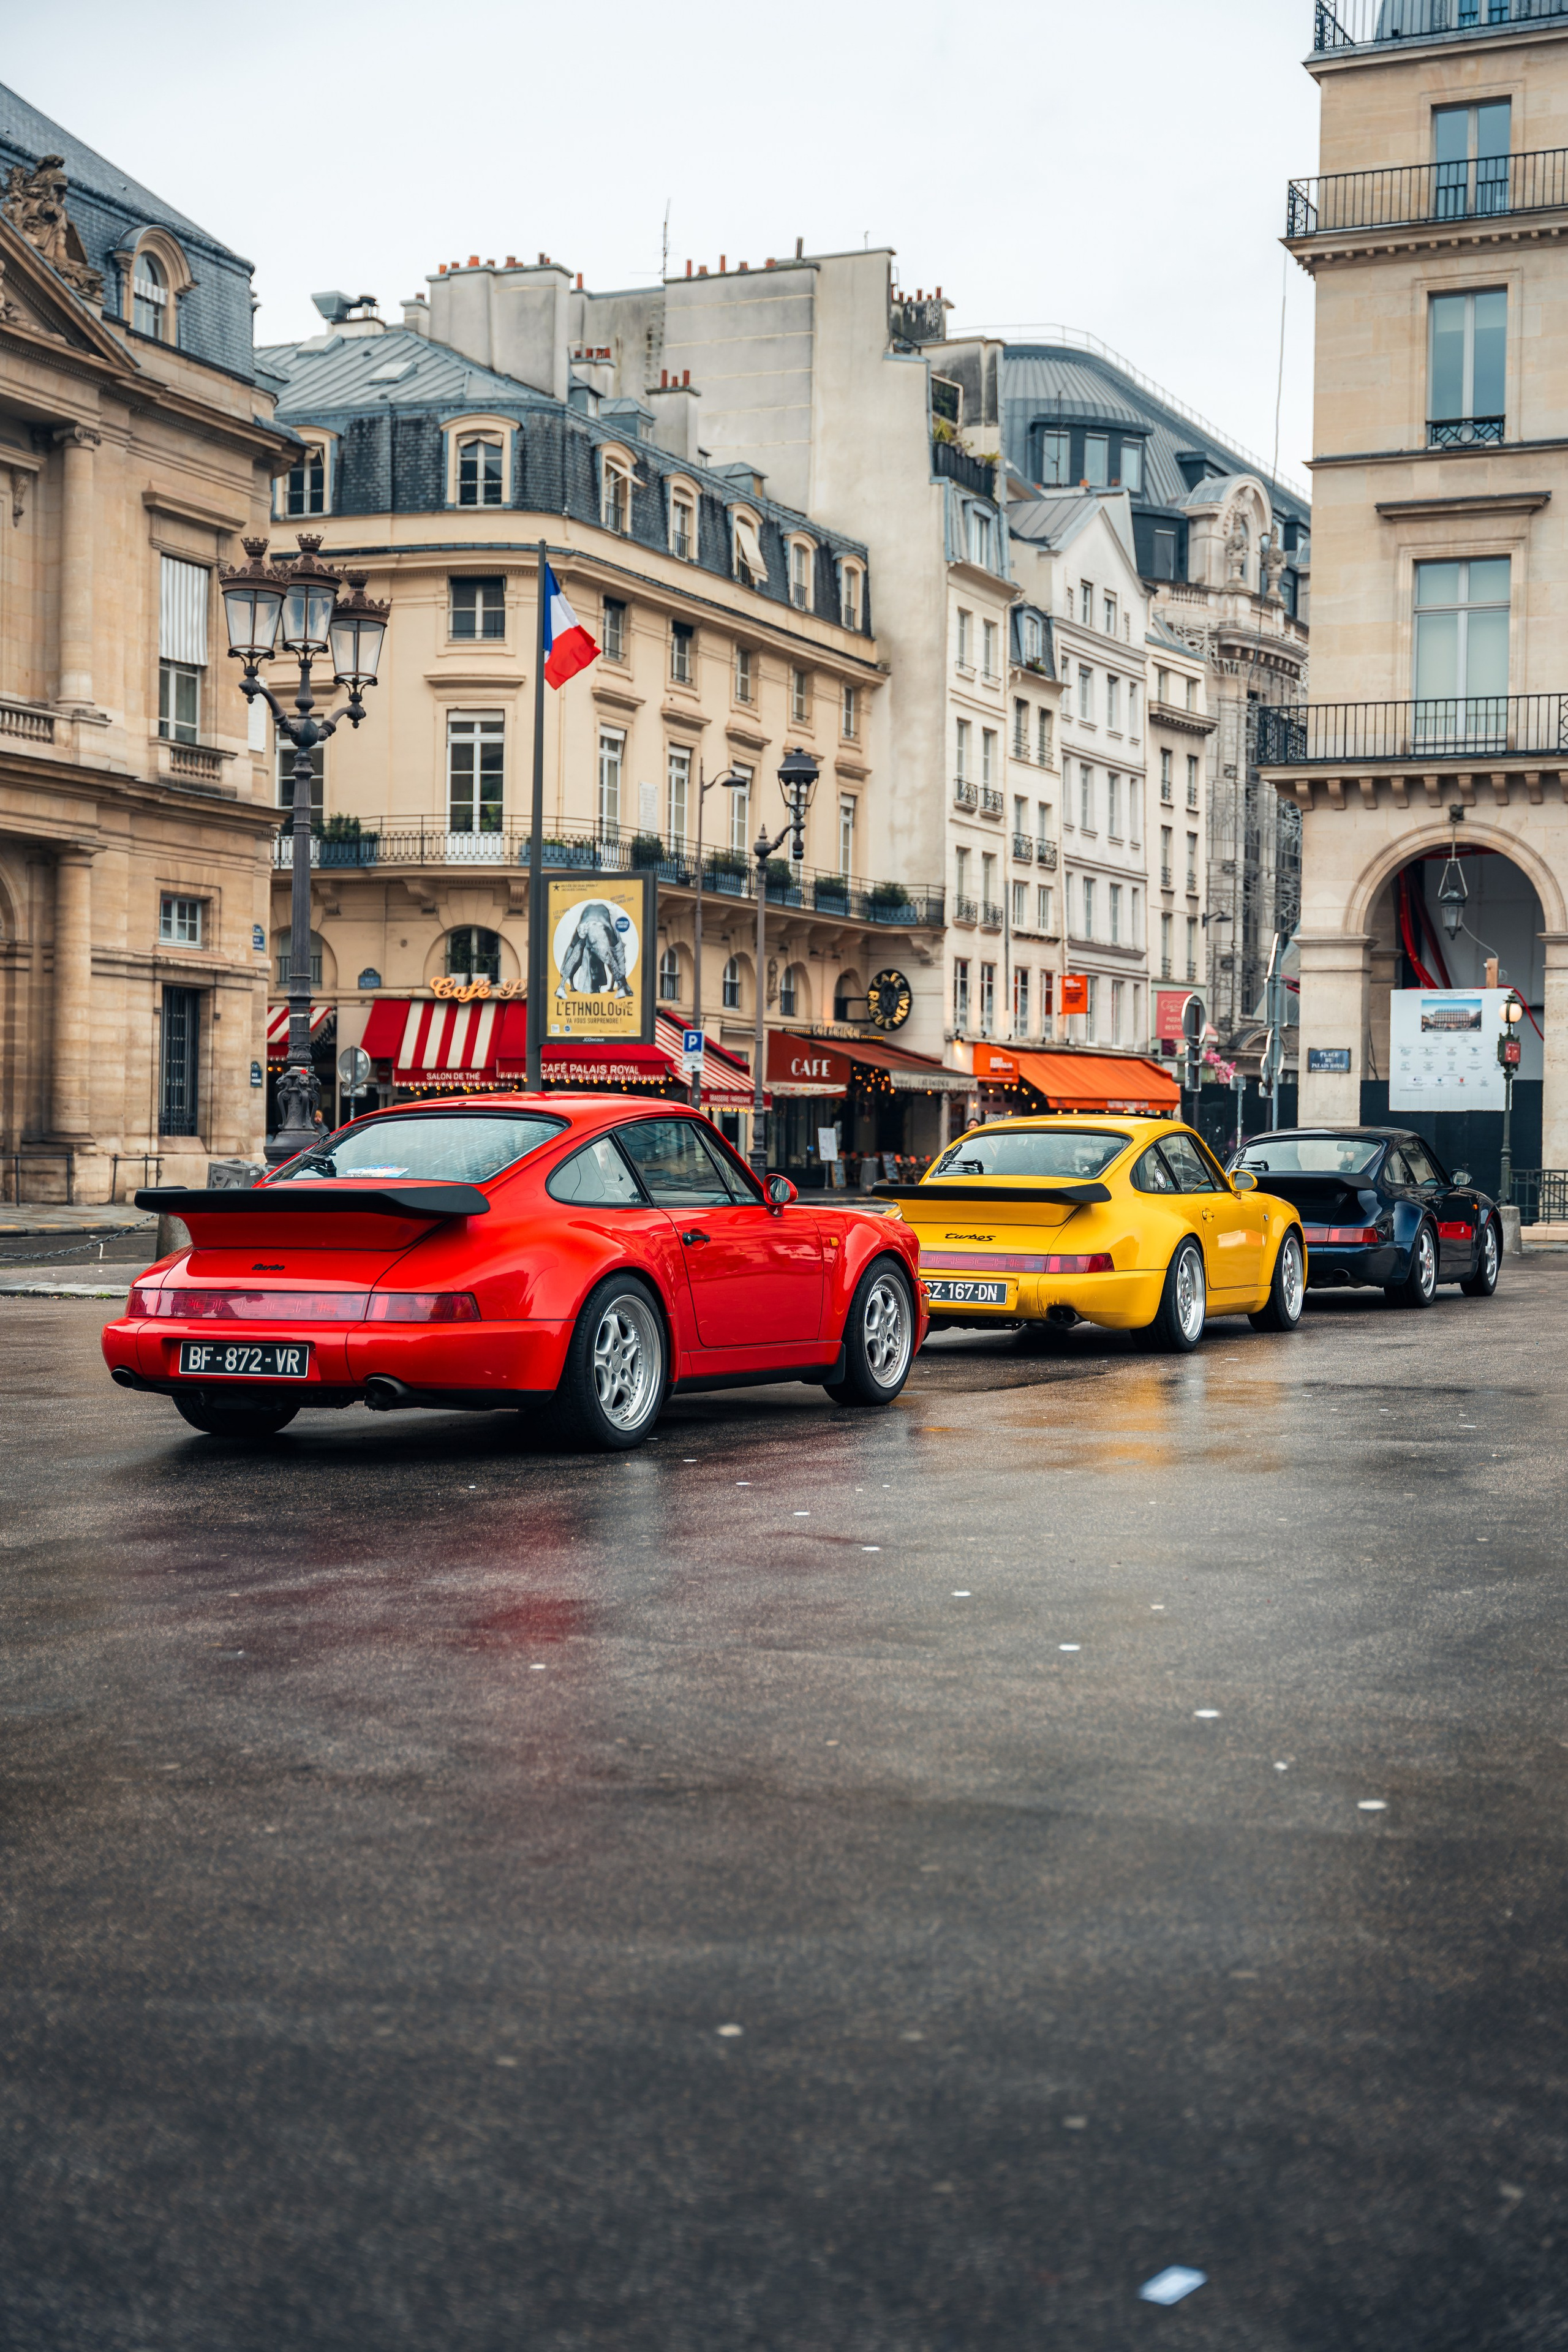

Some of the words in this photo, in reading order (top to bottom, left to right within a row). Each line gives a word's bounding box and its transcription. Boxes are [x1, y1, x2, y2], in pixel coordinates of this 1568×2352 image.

[430, 976, 491, 1003] Café
[556, 1001, 633, 1016] L'ETHNOLOGIE
[688, 1035, 698, 1049] P
[541, 1061, 567, 1072] CAFÉ
[570, 1064, 608, 1074] PALAIS
[610, 1065, 639, 1075] ROYAL
[791, 1058, 831, 1077] CAFE
[426, 1072, 451, 1080] SALON
[465, 1071, 481, 1080] THÉ
[709, 1093, 729, 1102] BRASSERIE
[171, 1297, 352, 1314] PORSCHE
